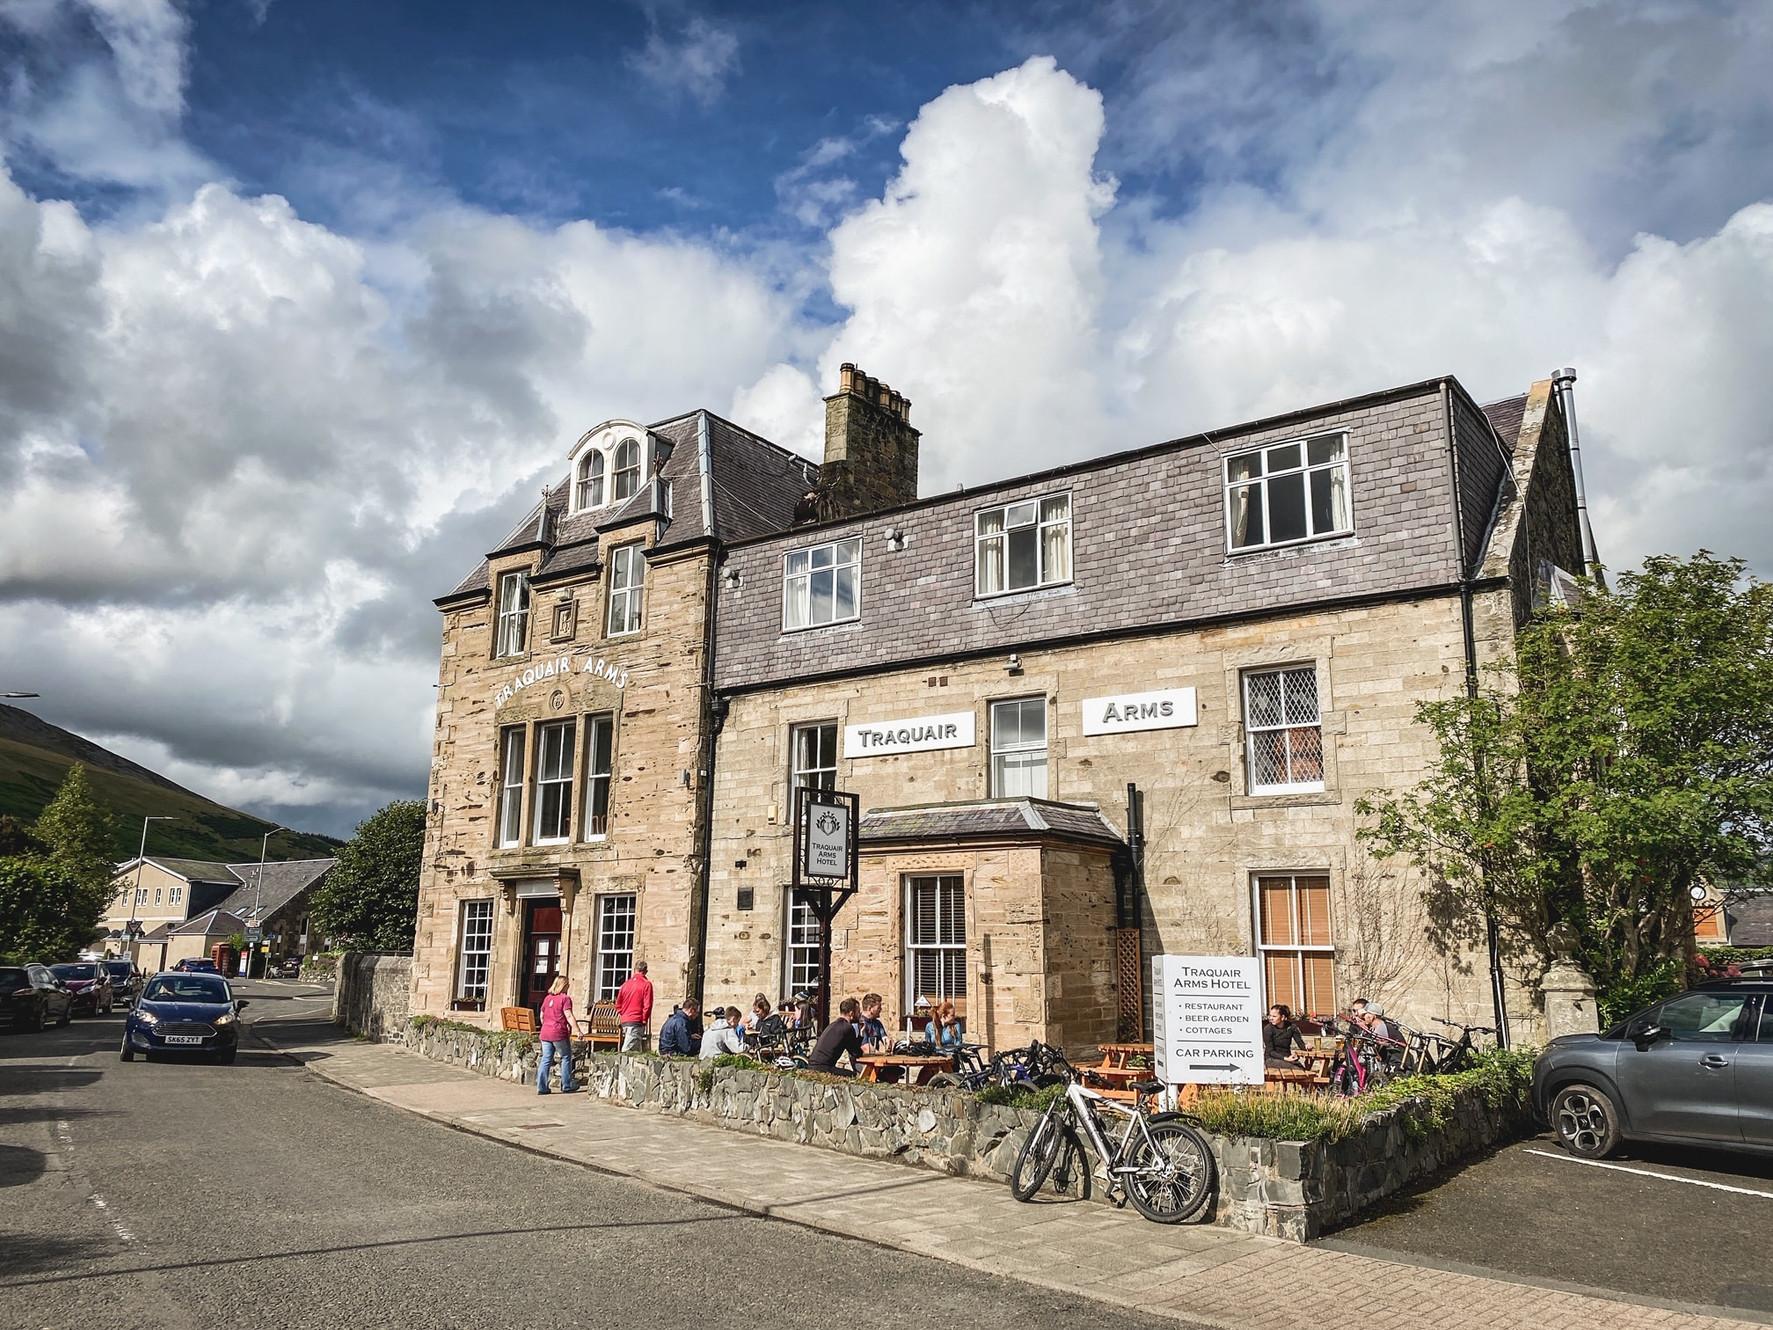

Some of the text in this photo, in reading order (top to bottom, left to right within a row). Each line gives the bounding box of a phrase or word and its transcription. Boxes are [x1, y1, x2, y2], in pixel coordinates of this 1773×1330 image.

[494, 656, 629, 709] TRAQUAIR ARMS
[1102, 700, 1174, 723] ARMS
[858, 723, 958, 748] TRAQUAIR
[812, 842, 843, 852] TRAQUAIR
[816, 858, 837, 866] HOTEL
[1182, 967, 1241, 977] TRAQUAIR
[1173, 978, 1251, 989] ARMS HOTEL
[1184, 1003, 1244, 1011] RESTAURANT
[1211, 1015, 1249, 1023] GARDEN
[1175, 1048, 1200, 1058] CAR
[1203, 1049, 1254, 1059] PARKING
